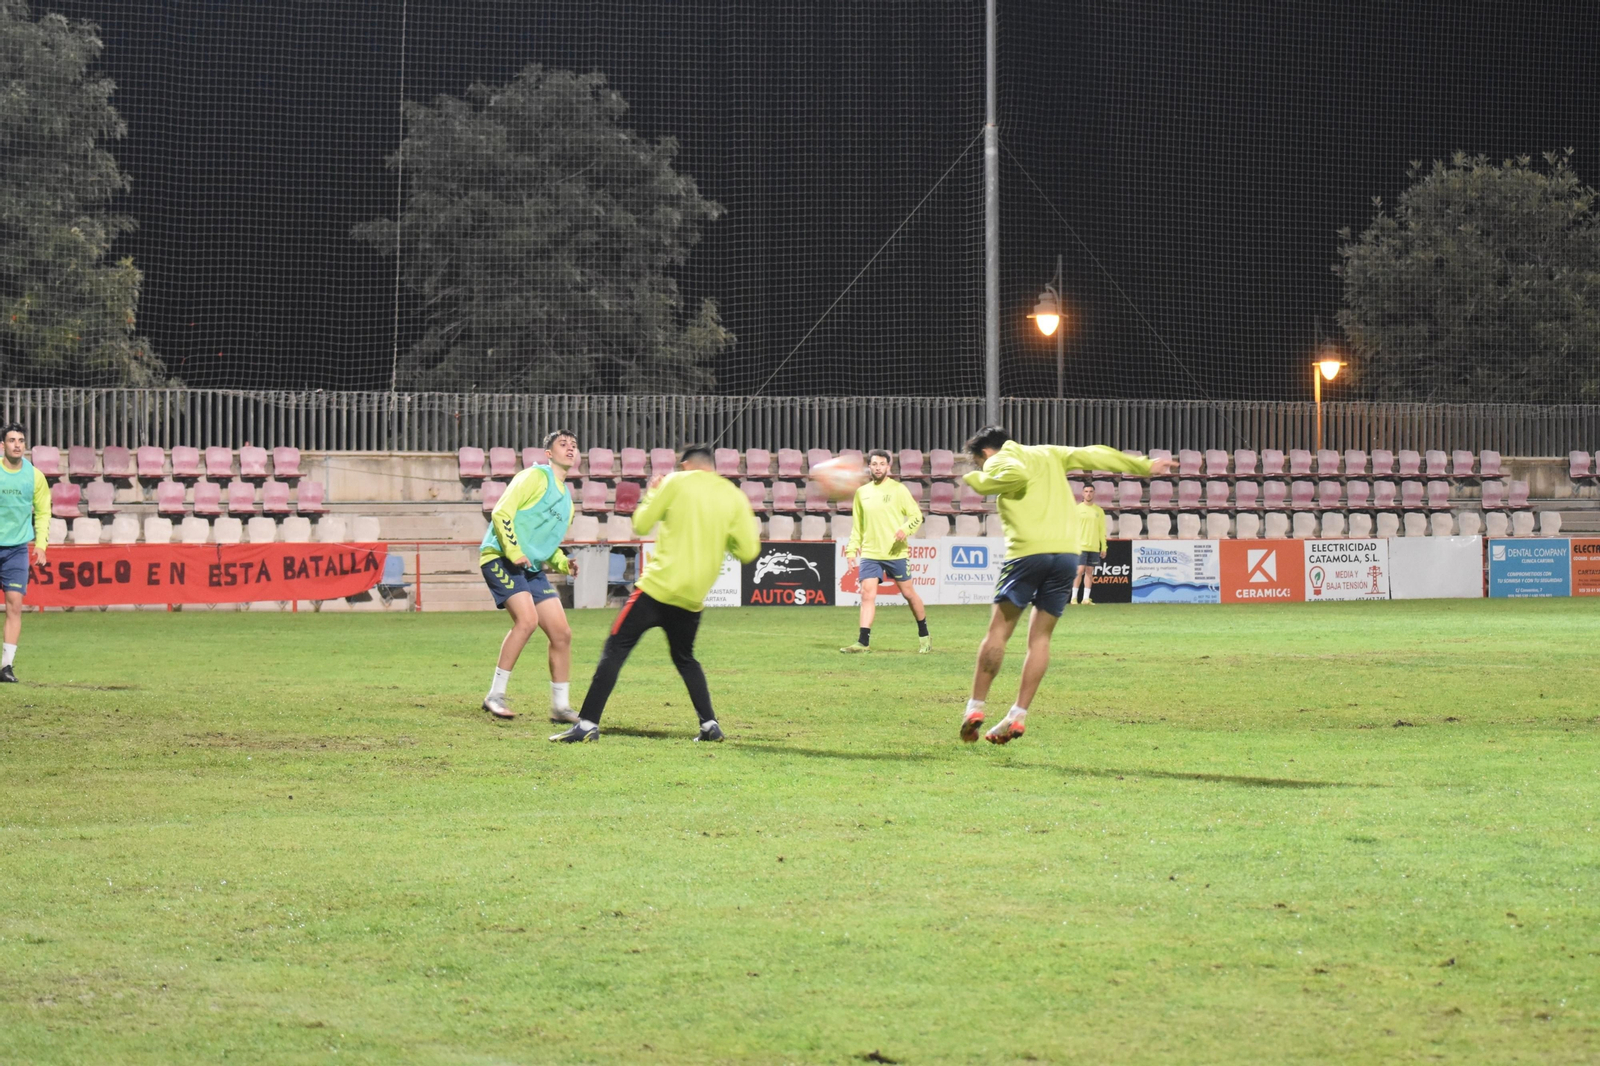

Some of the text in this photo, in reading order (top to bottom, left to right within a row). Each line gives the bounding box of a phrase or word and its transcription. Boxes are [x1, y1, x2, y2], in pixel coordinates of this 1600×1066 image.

[908, 547, 937, 558] BERTO
[1140, 547, 1177, 555] Salazones
[1312, 543, 1377, 552] ELECTRICIDAD
[1508, 548, 1567, 557] DENTAL COMPANY
[1309, 554, 1380, 563] CATAMOLA, S.L.
[58, 560, 131, 590] SOLO
[147, 562, 185, 585] EN
[208, 559, 271, 587] ESTA
[283, 549, 379, 580] BATALLA
[1094, 562, 1130, 575] rket
[1326, 580, 1368, 590] BAJA TENSIÓN
[750, 589, 826, 604] AUTOSPA
